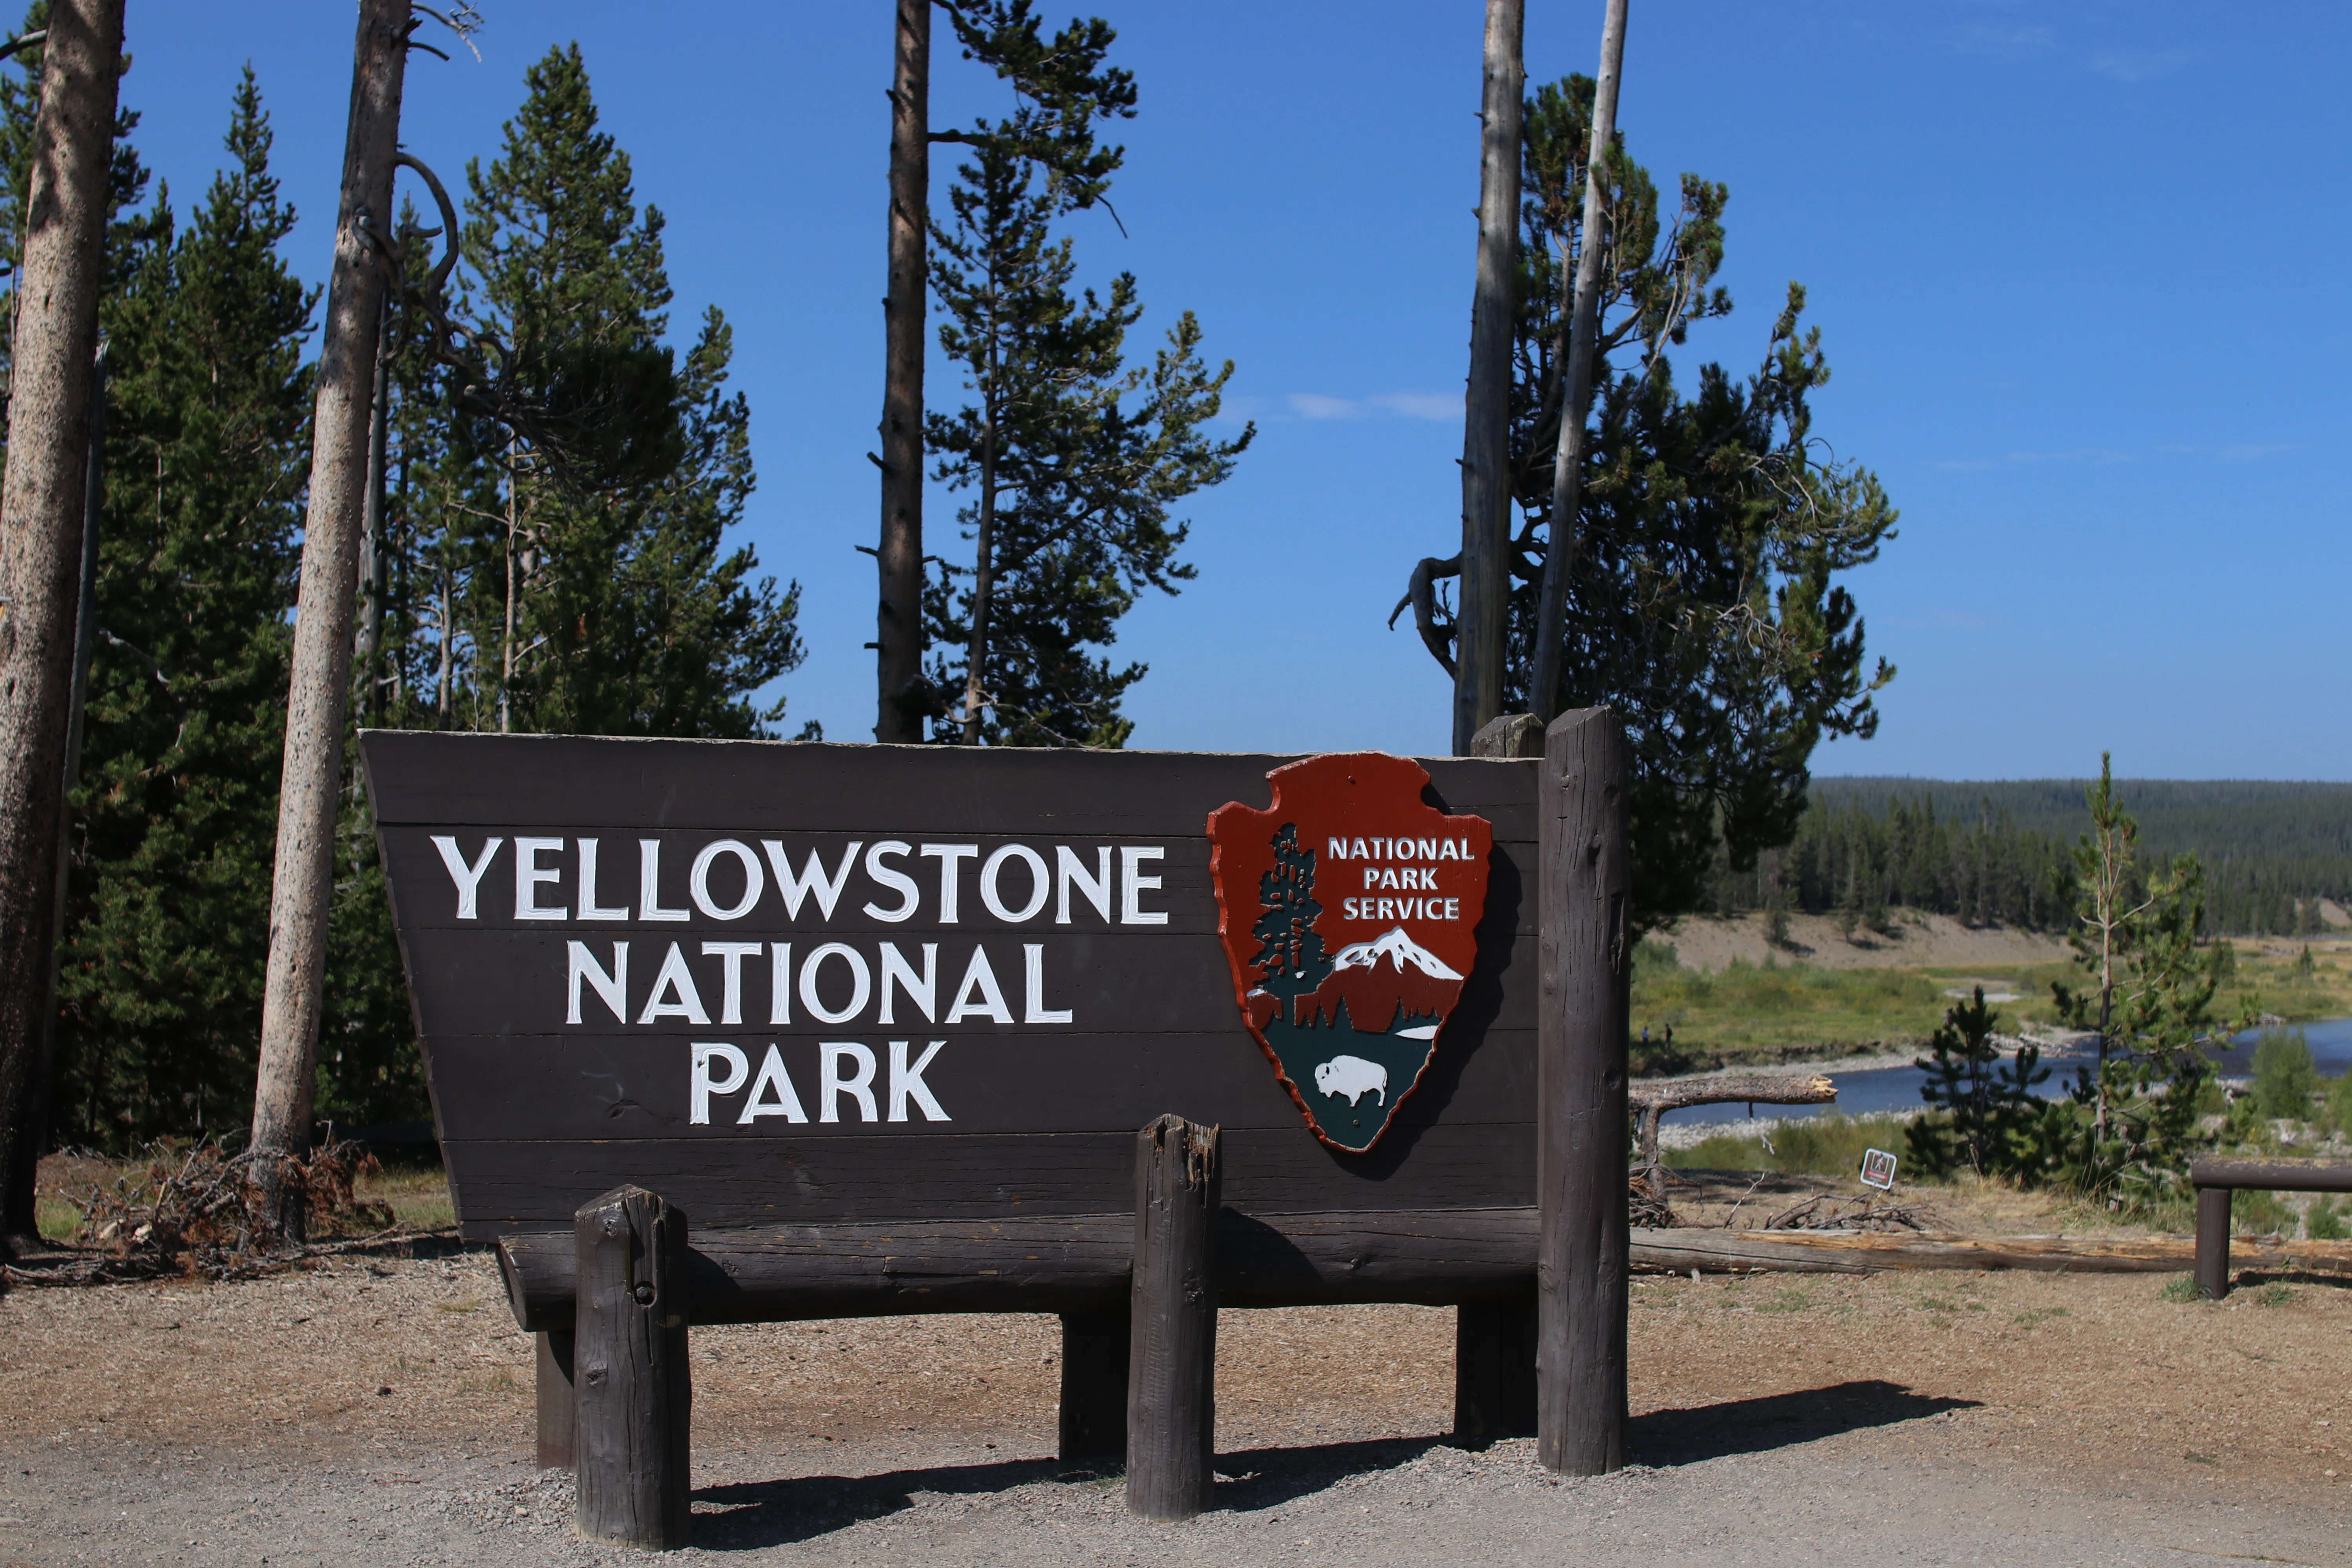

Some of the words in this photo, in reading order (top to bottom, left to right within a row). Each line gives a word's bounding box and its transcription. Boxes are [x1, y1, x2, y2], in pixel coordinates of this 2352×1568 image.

[1328, 837, 1475, 861] NATIONAL
[430, 835, 1169, 925] YELLOWSTONE
[1363, 867, 1439, 890] PARK
[1343, 897, 1460, 920] SERVICE
[565, 940, 1073, 1025] NATIONAL
[689, 1040, 952, 1125] PARK
